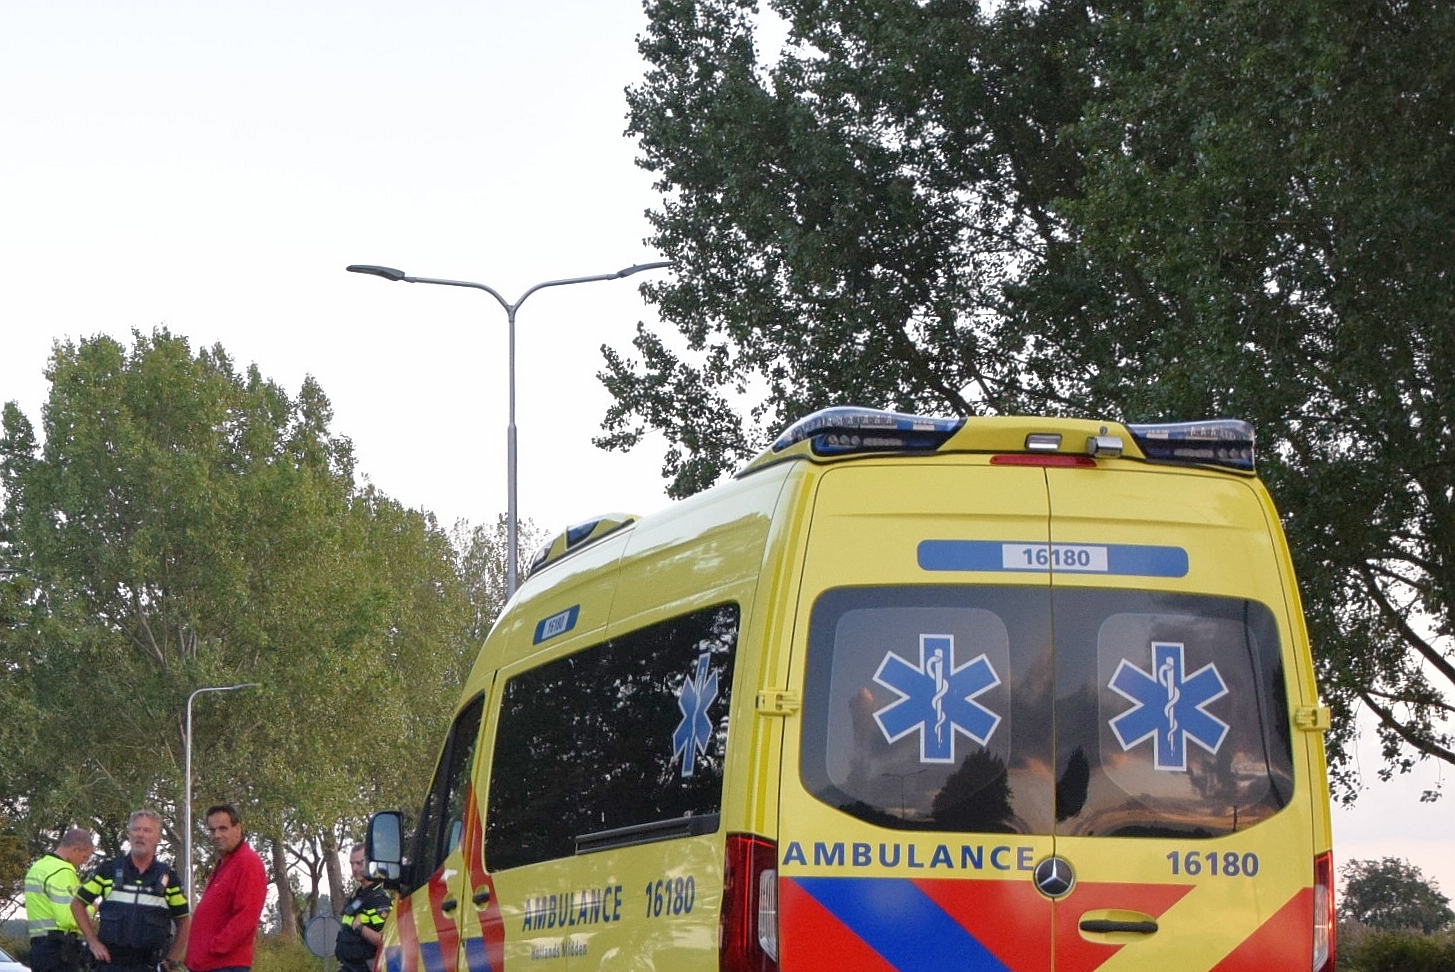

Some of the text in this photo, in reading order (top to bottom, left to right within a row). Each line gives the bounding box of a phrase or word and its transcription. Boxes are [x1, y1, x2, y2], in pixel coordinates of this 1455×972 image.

[1022, 548, 1090, 566] 16180
[781, 841, 1035, 871] AMBULANCE
[1166, 850, 1259, 877] 16180
[522, 875, 695, 932] AMBULANCE 16180
